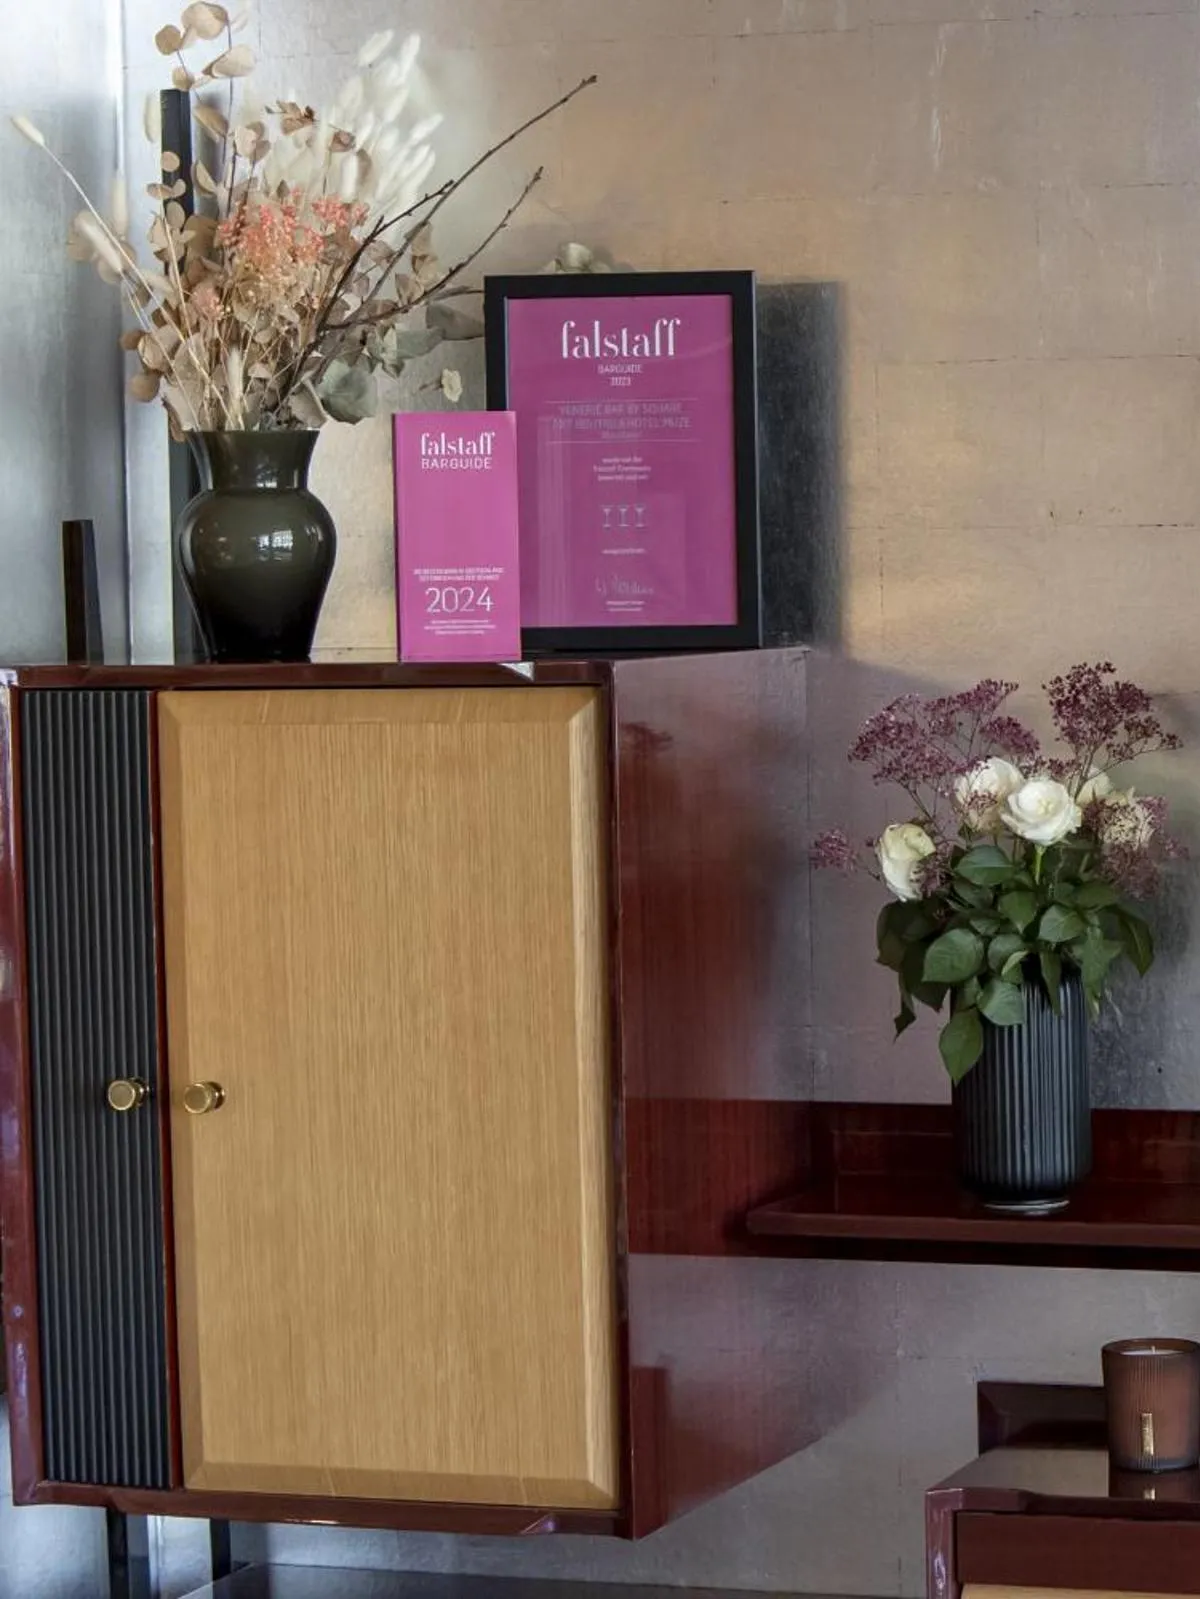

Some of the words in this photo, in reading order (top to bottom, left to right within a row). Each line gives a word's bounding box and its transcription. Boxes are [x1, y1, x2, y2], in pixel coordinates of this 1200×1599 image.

[562, 318, 681, 359] falstaff
[421, 432, 496, 456] falstaff
[421, 457, 492, 470] BARGUIDE
[425, 586, 494, 612] 2024
